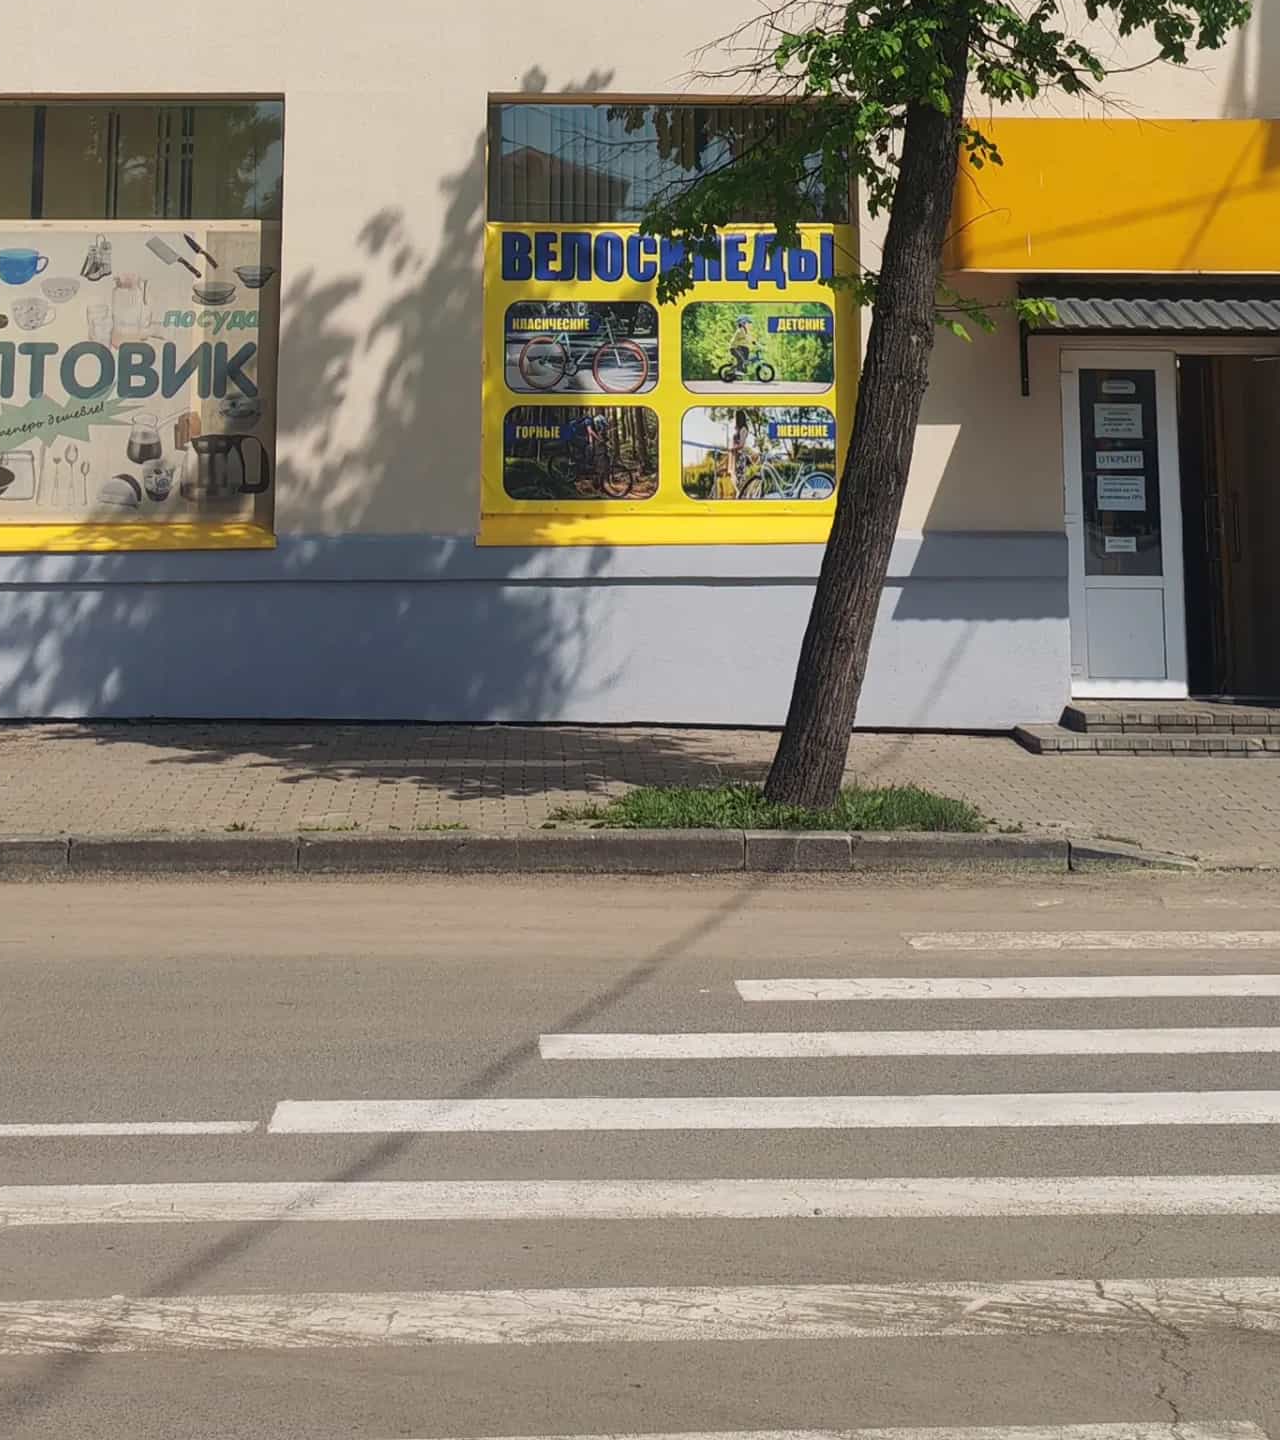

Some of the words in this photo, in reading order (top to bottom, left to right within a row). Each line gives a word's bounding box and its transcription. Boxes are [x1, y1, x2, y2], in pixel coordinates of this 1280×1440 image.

[162, 310, 263, 335] посуда
[777, 317, 826, 331] ДЕТСКИЕ
[515, 424, 561, 440] ГОРНЫЕ
[776, 424, 829, 437] ЖЕНСКИЕ
